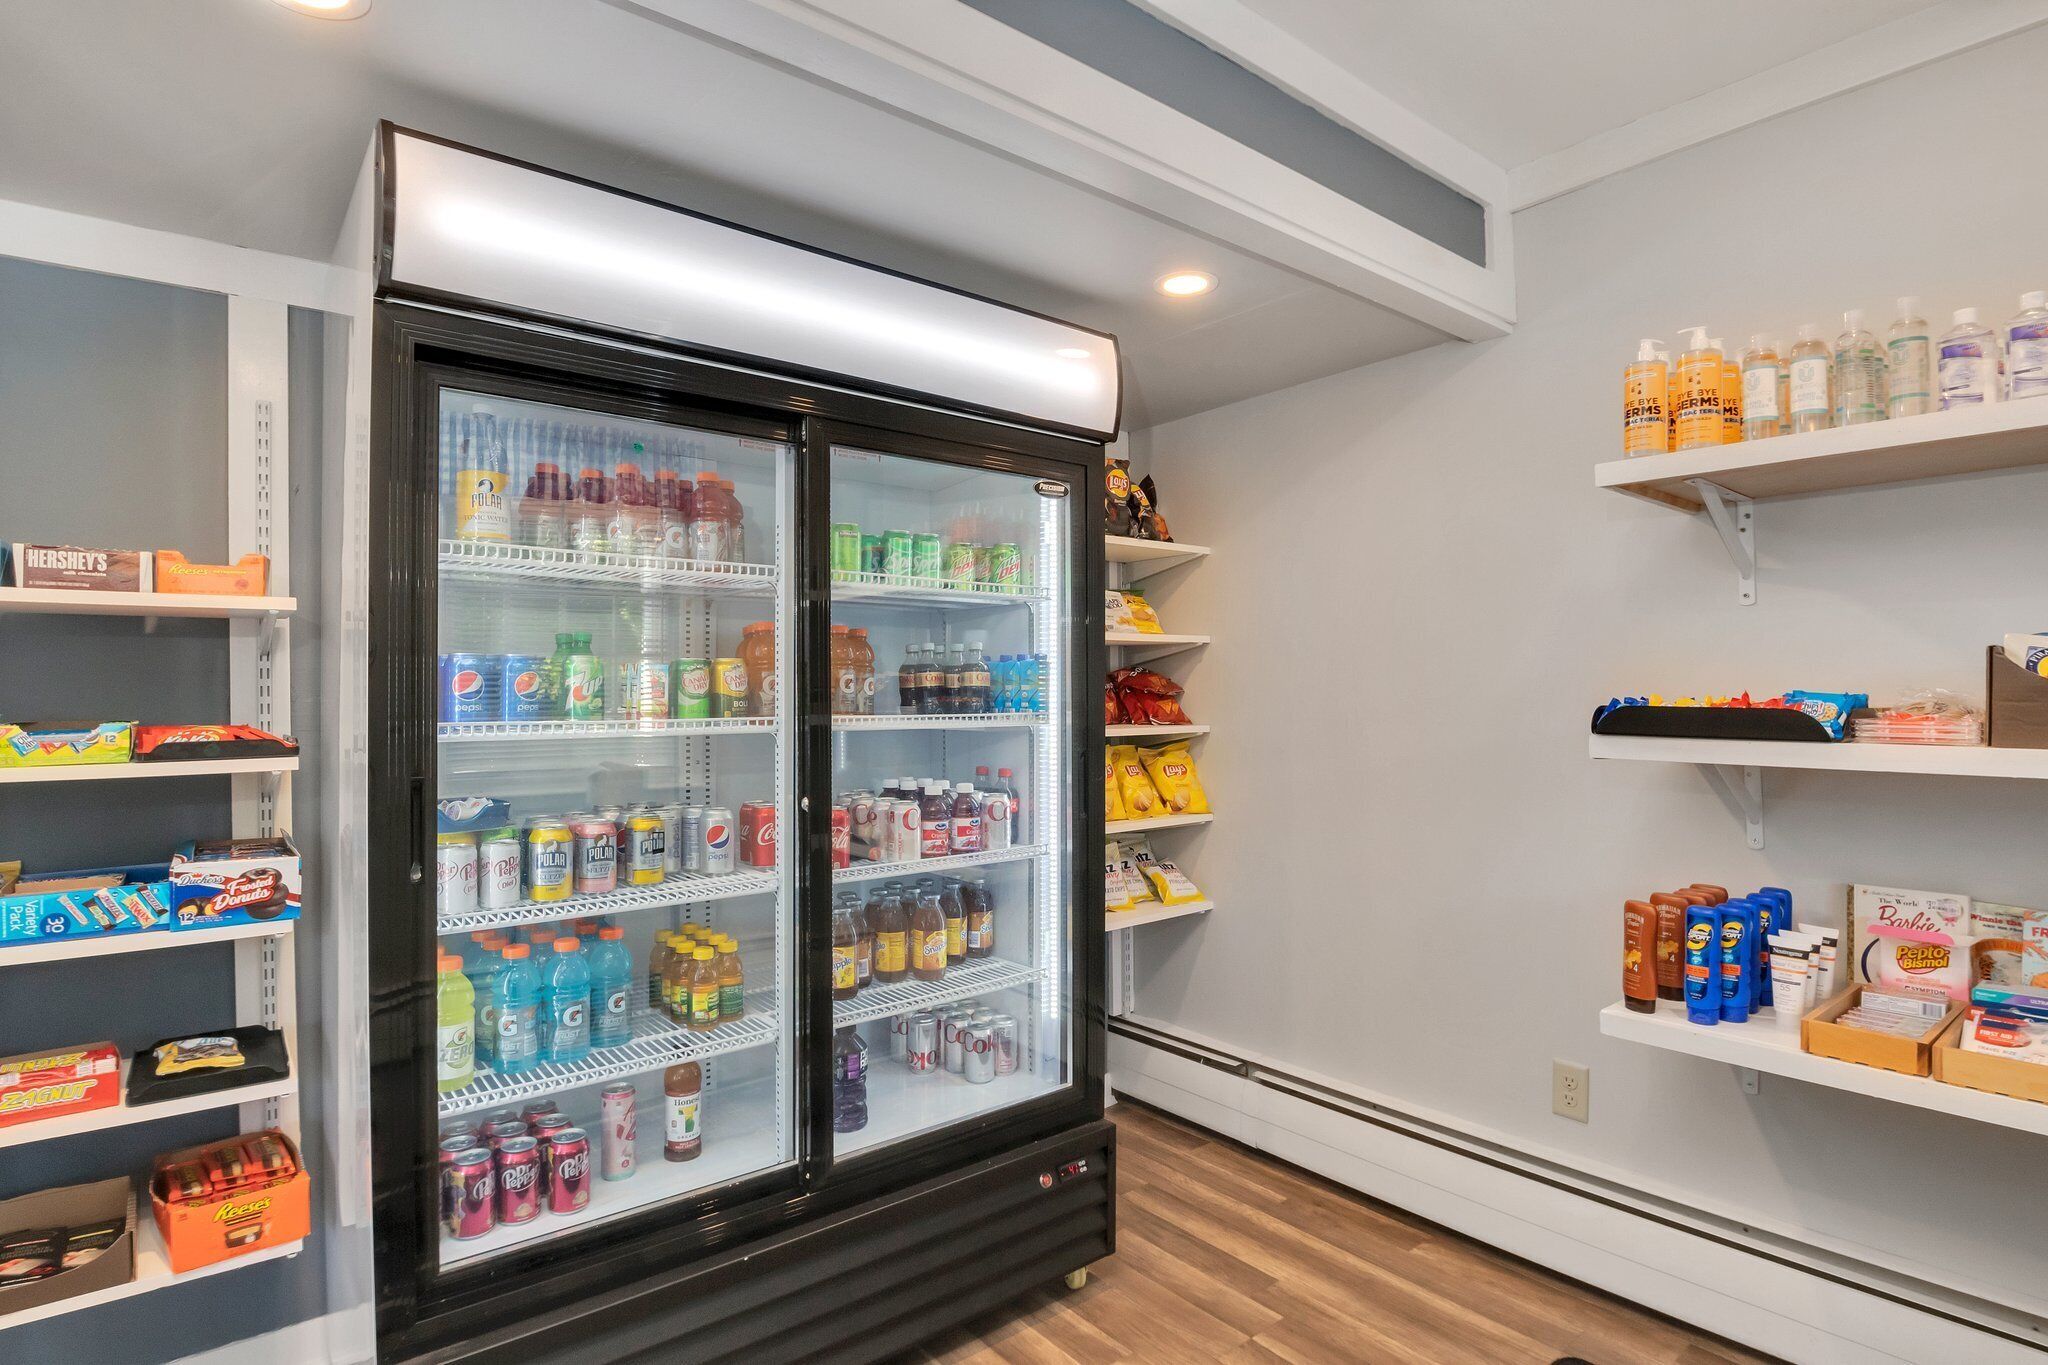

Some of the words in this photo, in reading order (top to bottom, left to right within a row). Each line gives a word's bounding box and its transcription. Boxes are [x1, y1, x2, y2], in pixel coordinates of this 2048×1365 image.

[1698, 388, 1717, 397] BYE
[1638, 397, 1658, 406] BYE
[1625, 405, 1661, 419] ERMS
[471, 493, 502, 510] POLAR
[27, 549, 108, 571] HERSHEY'S
[455, 704, 482, 713] pepsi
[105, 734, 117, 743] 12
[538, 853, 566, 867] POLAR
[588, 847, 614, 860] POLAR
[227, 875, 273, 895] Frosted
[213, 888, 271, 911] Donuts
[10, 906, 23, 931] Pack
[23, 900, 39, 936] Variety
[47, 916, 65, 934] 30
[180, 913, 194, 922] 12
[1878, 905, 1942, 932] Barbie
[1903, 956, 1949, 969] Bismol
[563, 1004, 583, 1027] G
[498, 1014, 518, 1036] G
[1980, 1029, 1998, 1037] FIRST
[2000, 1032, 2012, 1040] AID
[0, 1080, 97, 1111] ZAGNUT
[519, 1164, 531, 1177] Dr
[212, 1196, 273, 1223] Reese's
